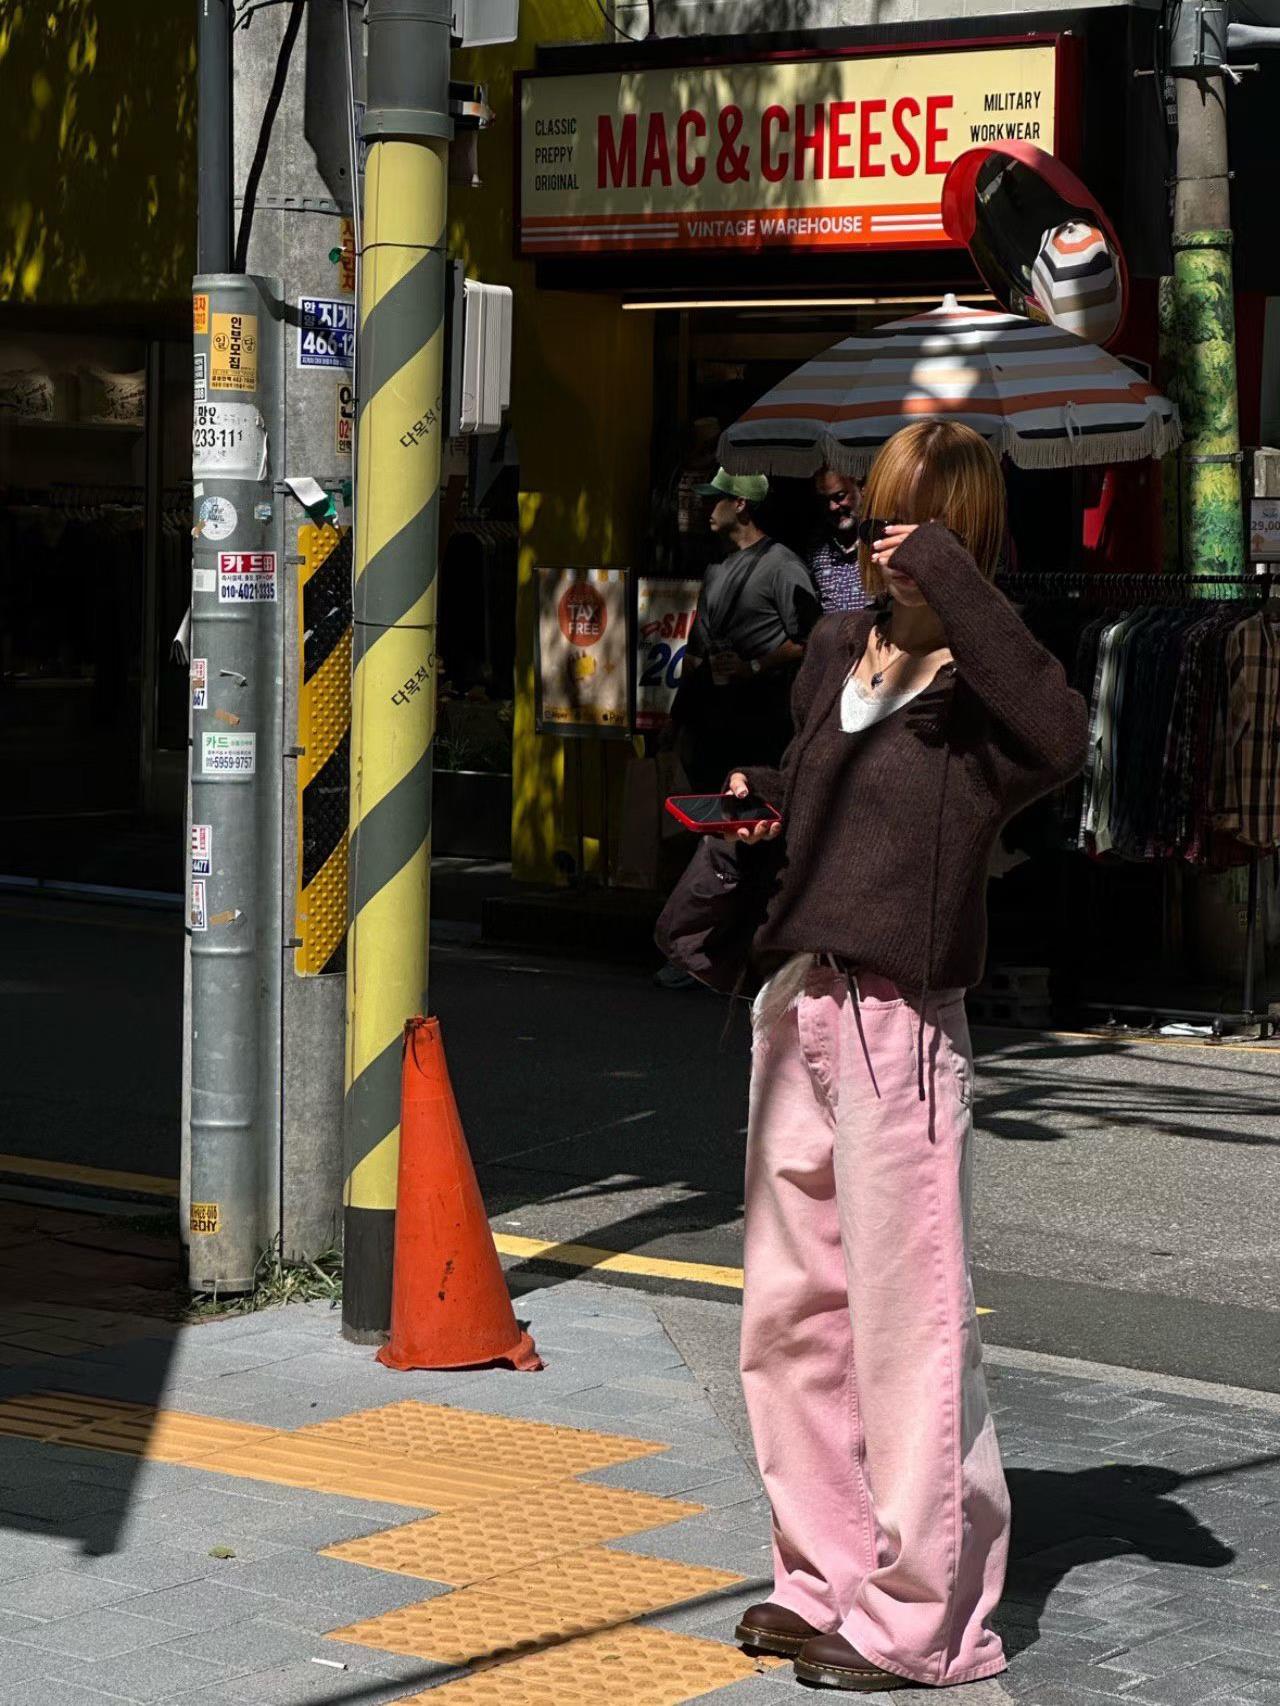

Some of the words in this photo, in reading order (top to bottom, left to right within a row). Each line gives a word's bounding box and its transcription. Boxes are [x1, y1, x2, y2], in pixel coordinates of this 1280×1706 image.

[984, 91, 1041, 111] MILITARY
[535, 118, 577, 136] CLASSIC
[970, 122, 1040, 142] WORKWEAR
[535, 147, 573, 163] PREPPY
[535, 174, 579, 191] ORIGINAL
[687, 219, 756, 237] VINTAGE
[760, 216, 863, 235] WAREHOUSE
[400, 408, 437, 447] 다목적
[568, 604, 597, 622] TAX
[568, 622, 600, 635] FREE
[391, 666, 429, 705] 다목적
[205, 736, 229, 748] 카드
